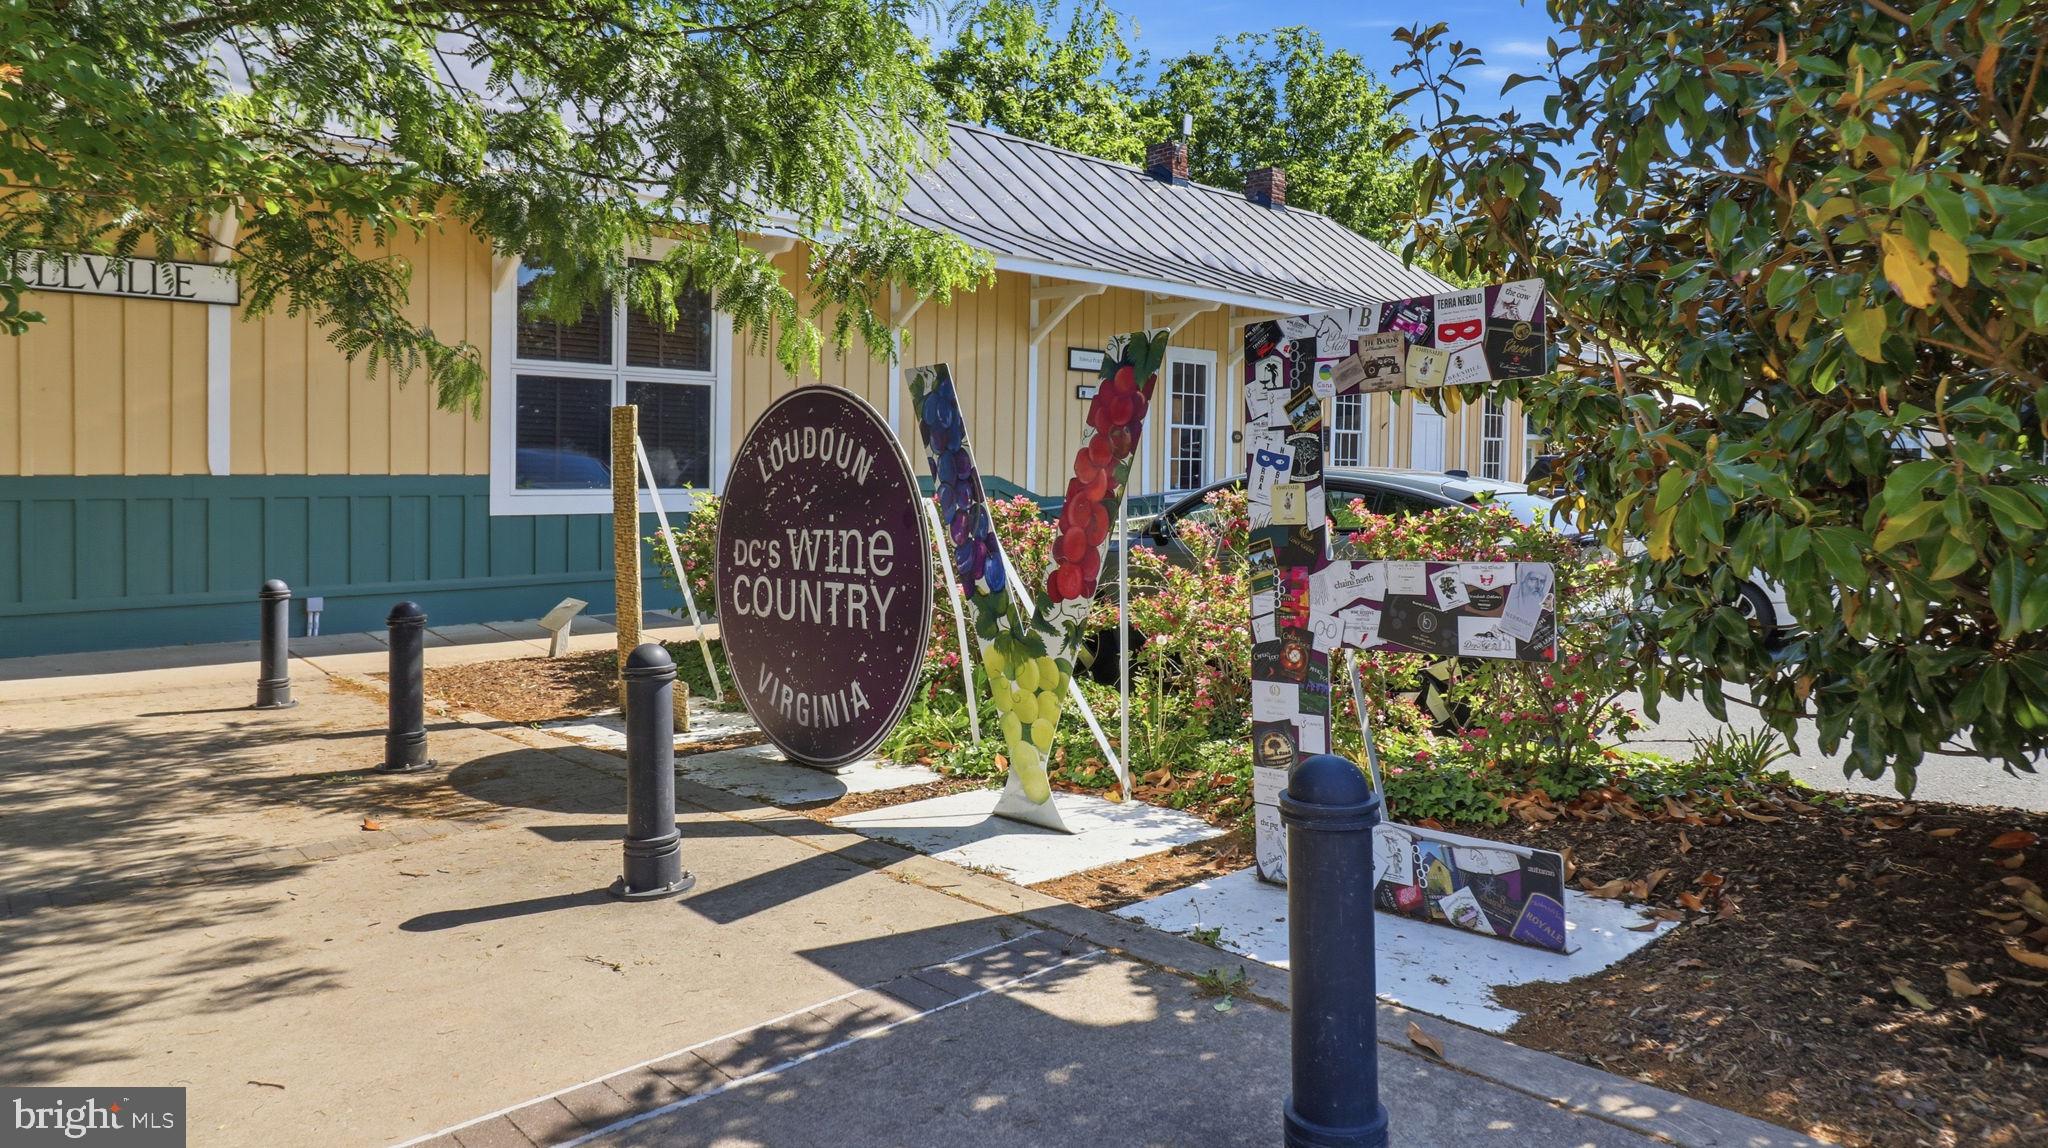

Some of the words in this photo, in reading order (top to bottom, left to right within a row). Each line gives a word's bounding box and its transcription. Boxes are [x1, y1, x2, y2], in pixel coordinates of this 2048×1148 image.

[1437, 297, 1457, 310] TERRA
[1457, 293, 1482, 306] NEBULO
[1516, 292, 1531, 300] cow
[1359, 307, 1372, 327] B
[757, 426, 874, 486] LOUDOUN
[734, 539, 781, 569] DC'S
[1334, 578, 1355, 589] chains
[1356, 573, 1375, 585] north
[1349, 570, 1355, 579] 8
[733, 575, 896, 632] COUNTRY
[757, 663, 871, 728] VIRGINIA
[1260, 819, 1269, 827] the
[1269, 822, 1279, 831] pig
[1527, 866, 1556, 877] autumn
[1526, 911, 1563, 944] ROYALE
